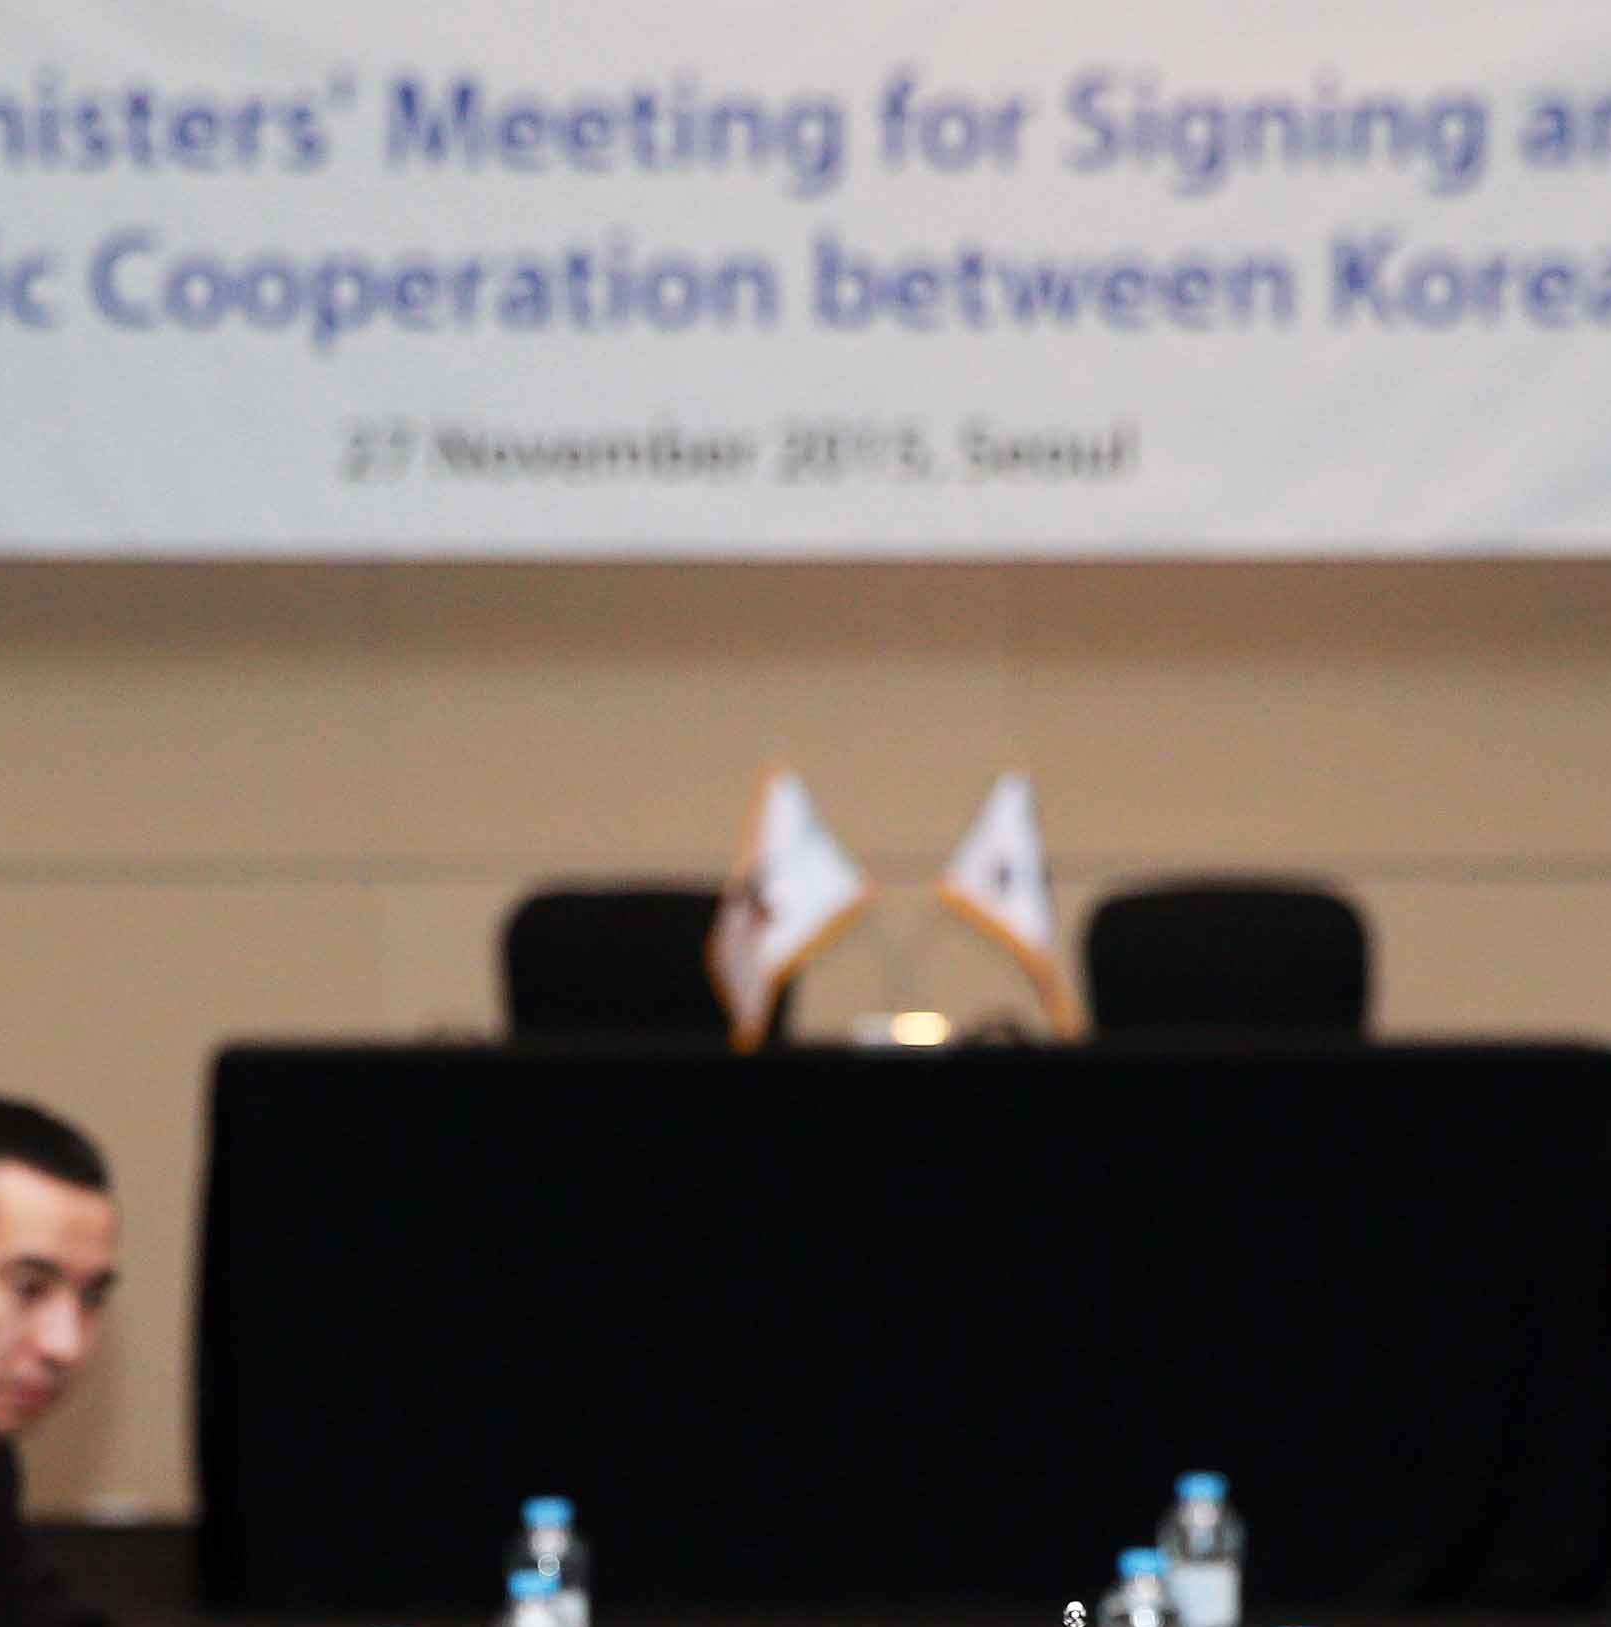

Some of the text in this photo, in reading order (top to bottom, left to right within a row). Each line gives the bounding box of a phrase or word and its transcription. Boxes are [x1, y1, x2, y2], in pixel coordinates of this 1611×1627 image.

[386, 74, 846, 194] Meeting
[880, 70, 1030, 165] for
[1066, 72, 1490, 192] Signing
[88, 232, 780, 350] Cooperation
[812, 236, 1296, 330] between
[342, 421, 416, 483] 27
[428, 420, 758, 482] November
[960, 416, 1140, 482] Seoul
